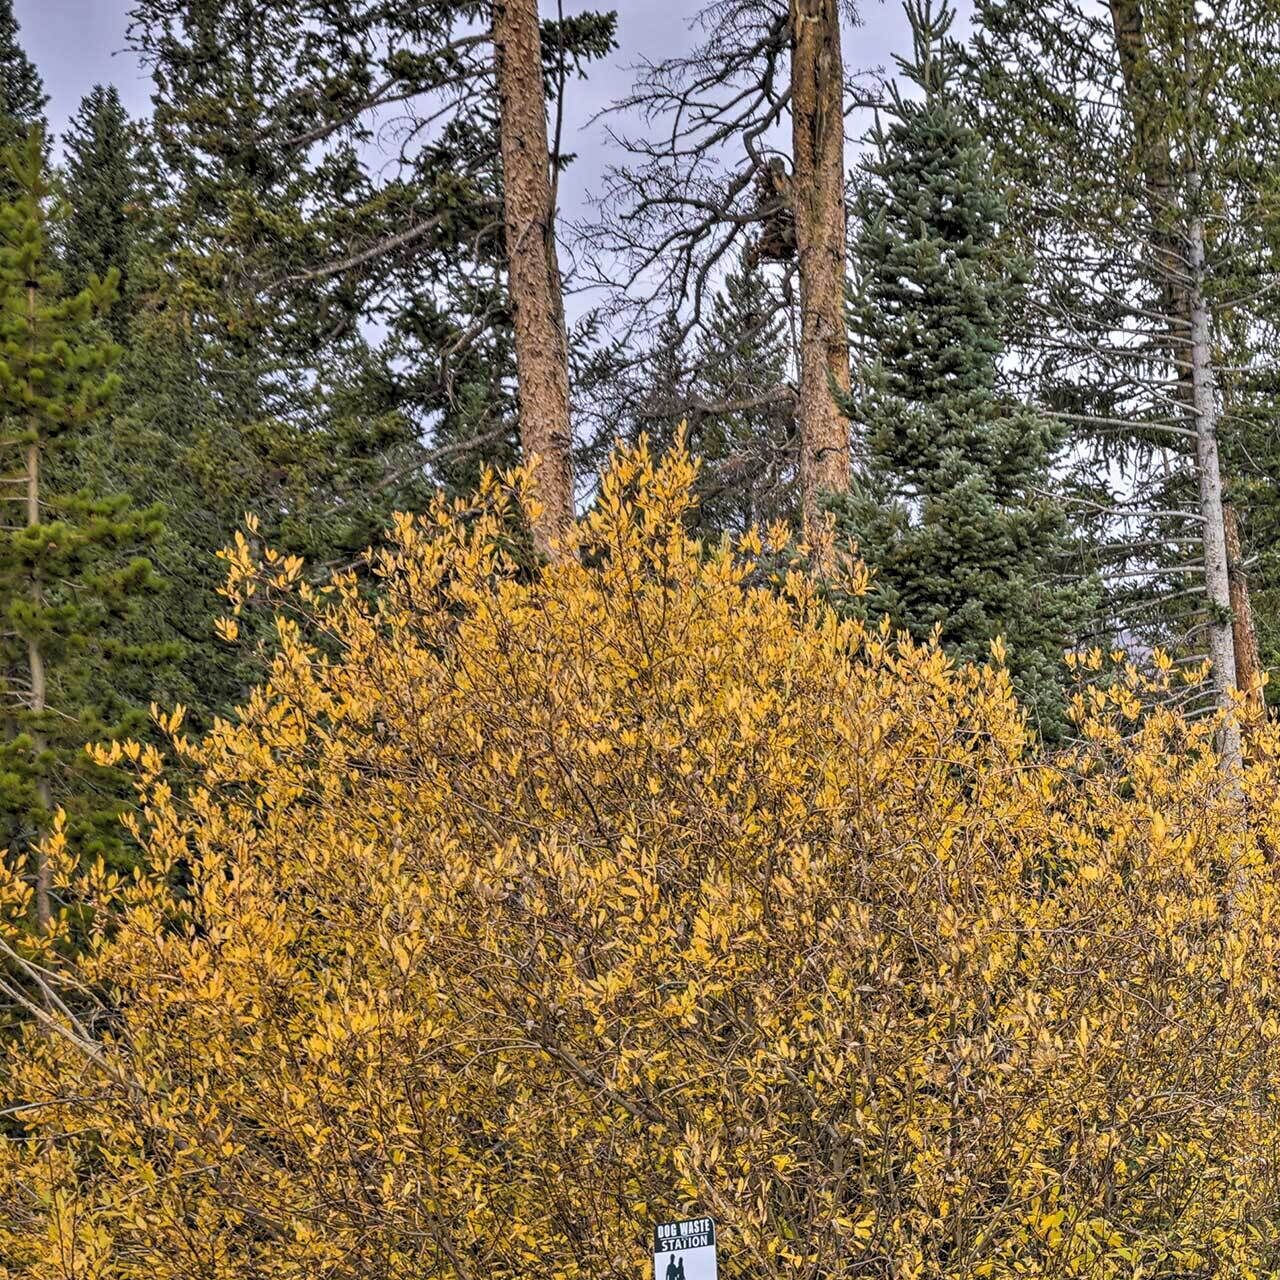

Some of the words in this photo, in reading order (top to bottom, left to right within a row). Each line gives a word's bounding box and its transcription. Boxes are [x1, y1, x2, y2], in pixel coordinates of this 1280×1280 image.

[658, 1224, 677, 1238] DOG
[680, 1218, 710, 1236] WASTE
[662, 1234, 708, 1252] STATION
